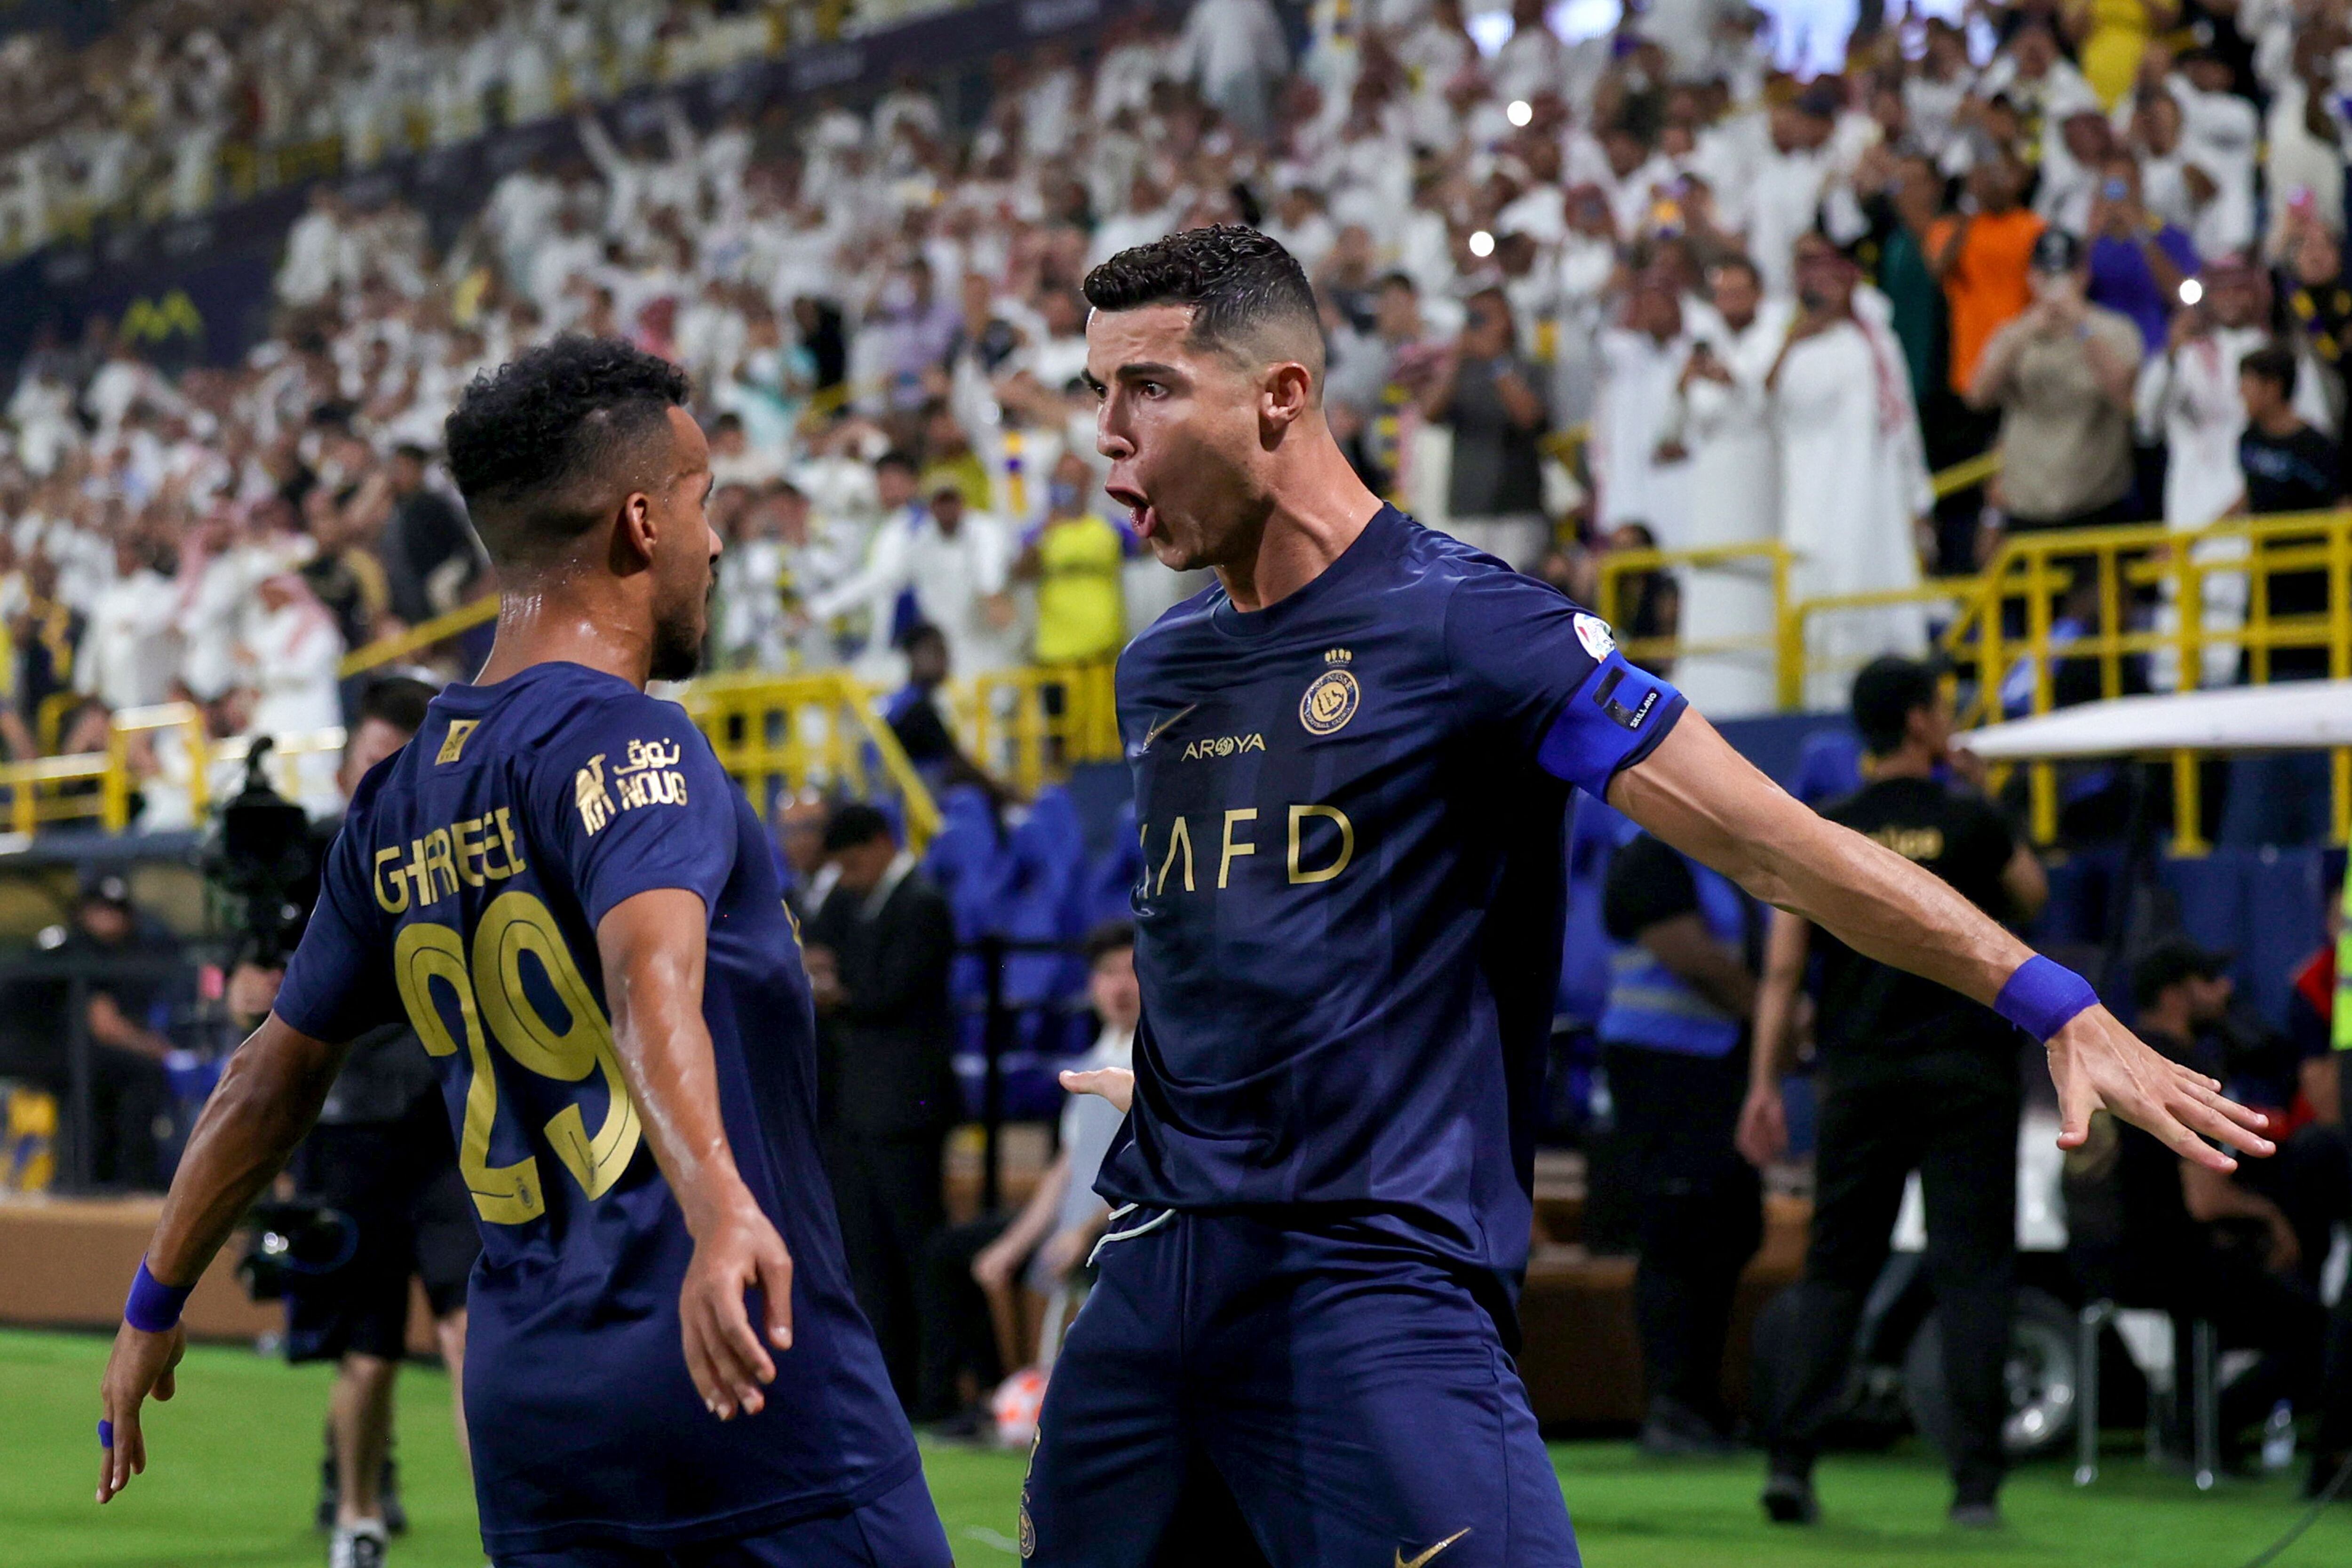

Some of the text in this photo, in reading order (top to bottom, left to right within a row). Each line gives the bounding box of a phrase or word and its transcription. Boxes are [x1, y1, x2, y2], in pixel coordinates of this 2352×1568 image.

[613, 738, 681, 775] نوق
[1181, 733, 1266, 761] AROYA
[615, 770, 688, 811] NOUG
[1140, 804, 1354, 899] AFD
[394, 891, 642, 1225] 29
